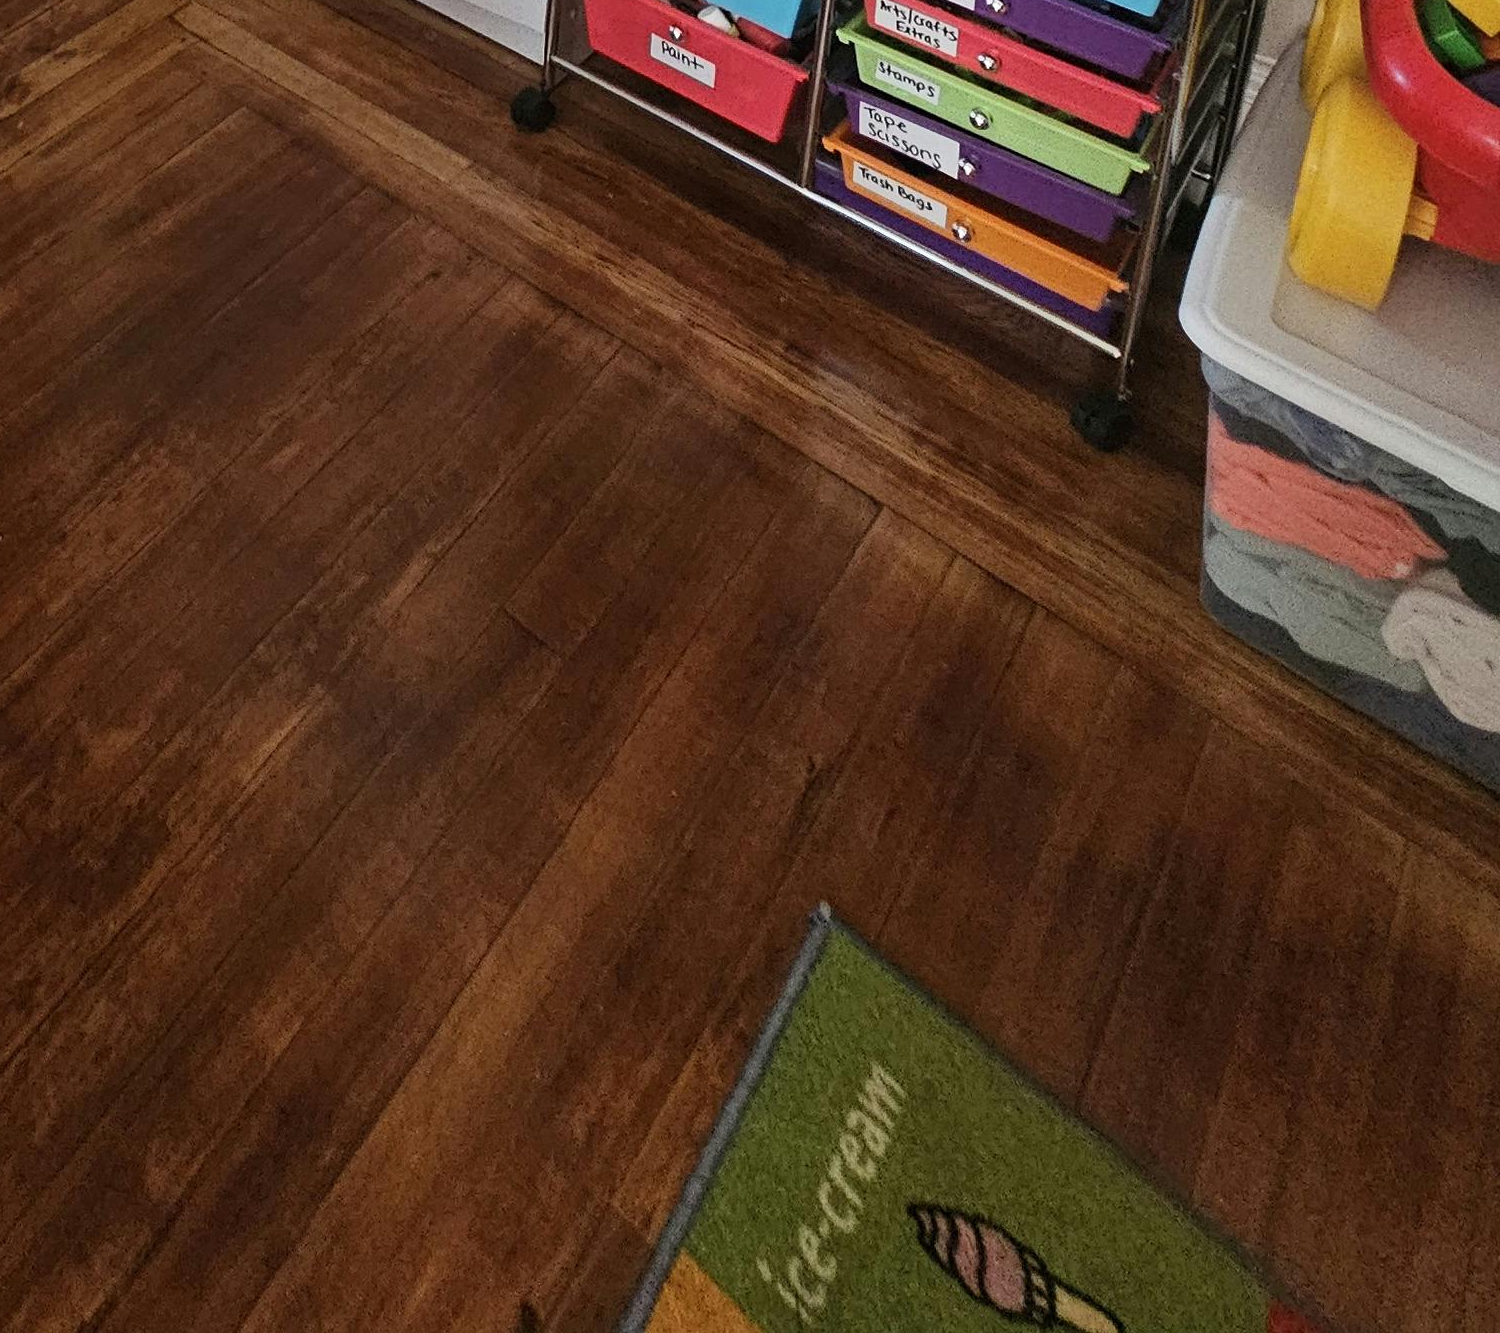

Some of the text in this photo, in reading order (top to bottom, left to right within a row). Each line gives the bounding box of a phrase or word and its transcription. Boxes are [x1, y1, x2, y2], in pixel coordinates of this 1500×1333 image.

[896, 21, 941, 49] Extras
[878, 61, 936, 97] Stamps
[864, 106, 908, 133] Tape
[868, 123, 941, 170] Scissors
[858, 167, 933, 211] Trash Bags
[756, 1061, 908, 1326] ice-cream
